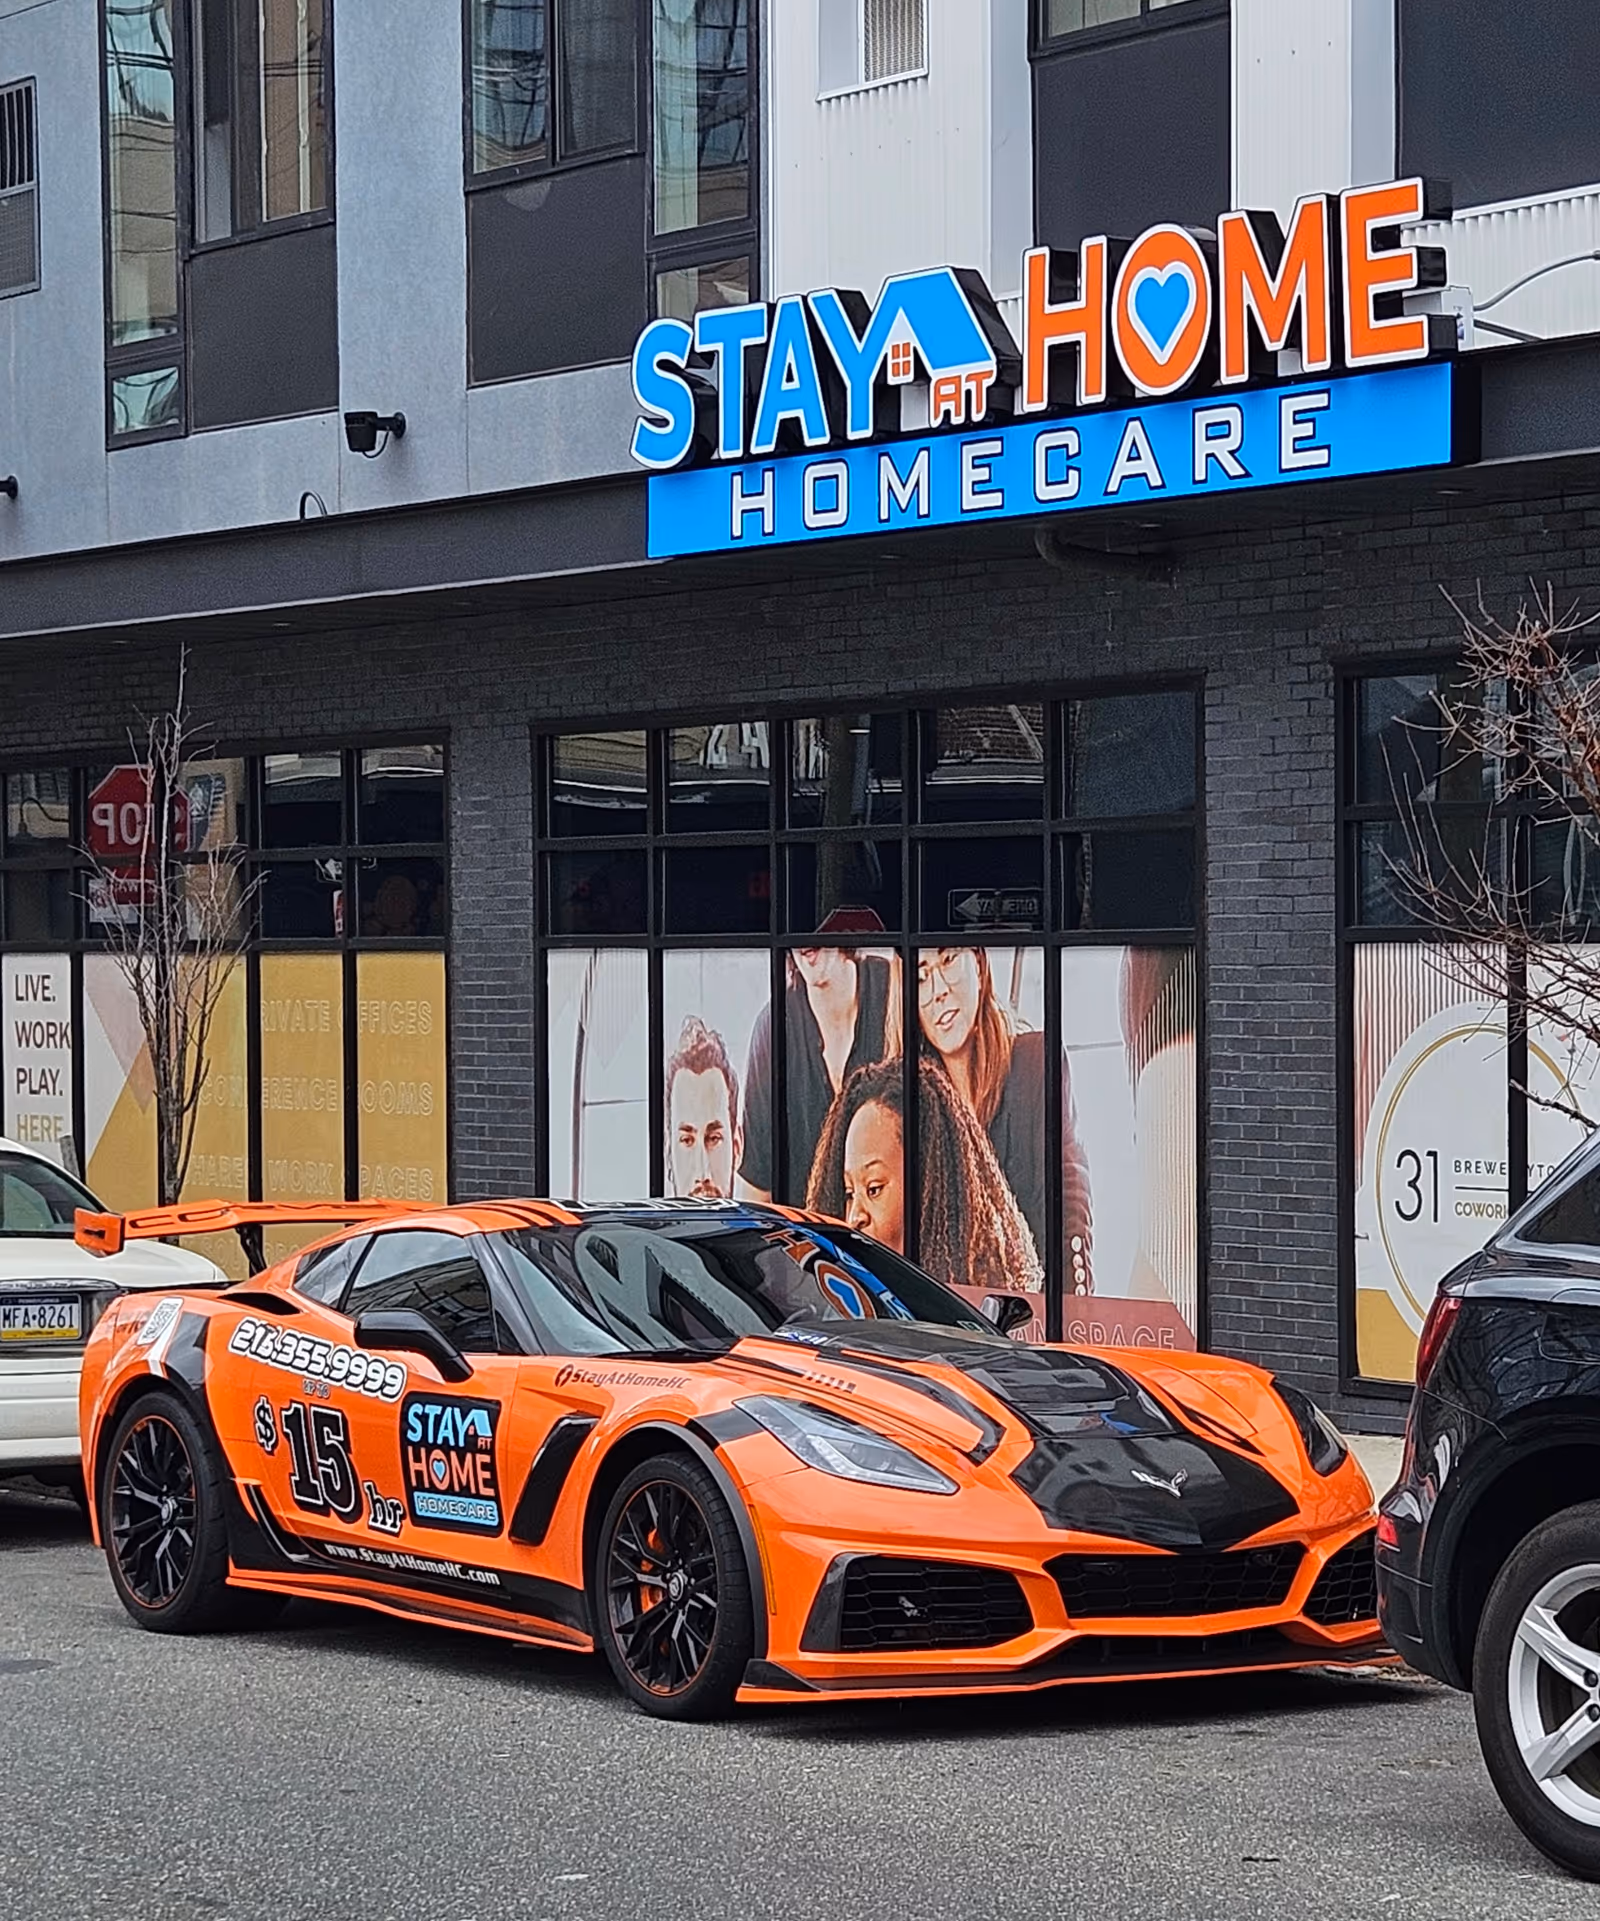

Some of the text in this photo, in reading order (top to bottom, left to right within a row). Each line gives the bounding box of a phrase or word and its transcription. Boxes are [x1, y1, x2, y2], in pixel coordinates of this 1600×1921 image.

[631, 177, 1430, 470] STAY AT HOME
[730, 392, 1332, 539] HOMECARE
[15, 974, 56, 1002] LIVE.
[16, 1067, 63, 1096] PLAY.
[361, 1080, 433, 1115] OOMS
[1395, 1149, 1438, 1223] 31
[571, 1368, 692, 1389] StayAtHomeHC
[407, 1403, 493, 1449] STAY AT
[408, 1446, 495, 1496] HOME
[364, 1481, 404, 1533] hr
[416, 1495, 496, 1519] HOMECARE
[324, 1543, 501, 1585] www.StayAtHomeHC.com
